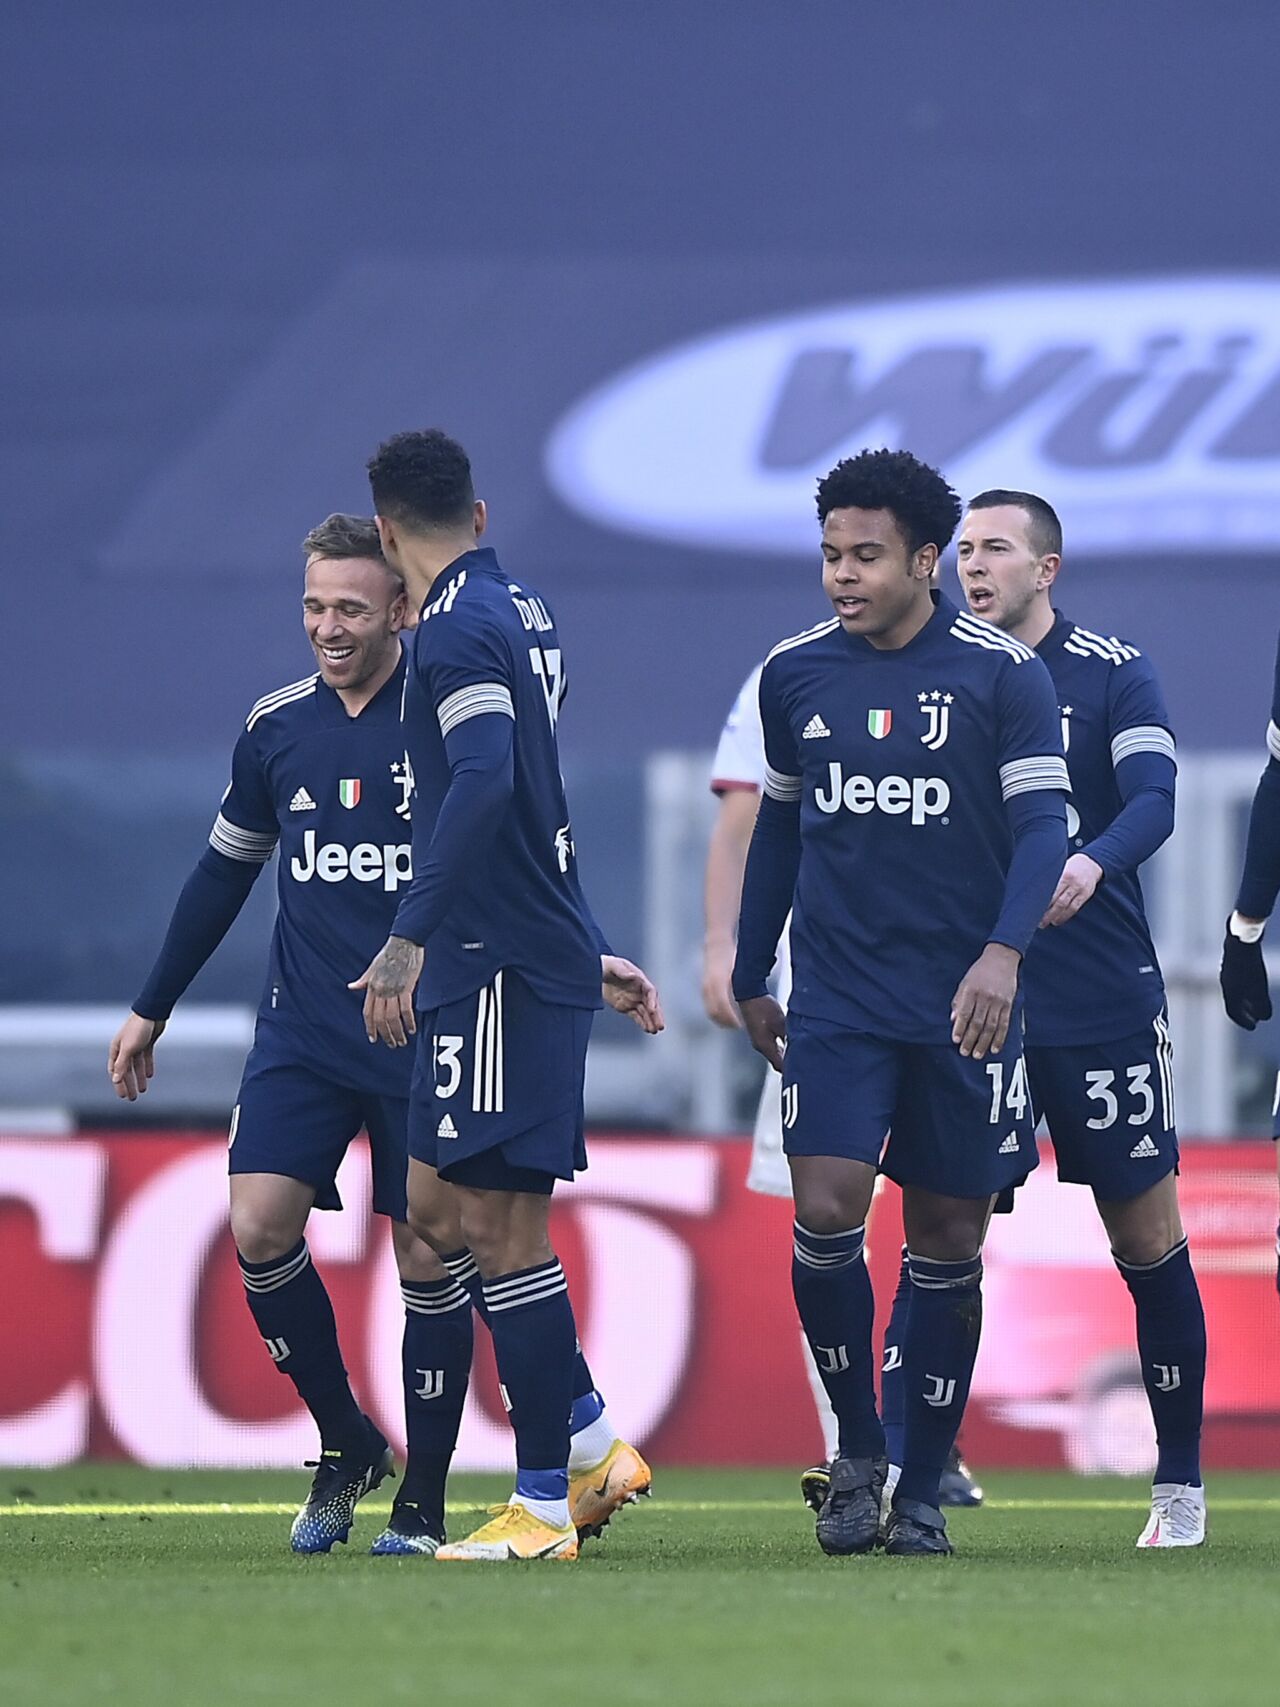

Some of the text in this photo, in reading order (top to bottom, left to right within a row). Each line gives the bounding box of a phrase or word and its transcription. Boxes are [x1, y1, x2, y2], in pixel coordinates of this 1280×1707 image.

[814, 762, 951, 826] Jeep
[291, 829, 413, 892] Jeep
[986, 1058, 1027, 1124] 14
[1085, 1063, 1155, 1130] 33
